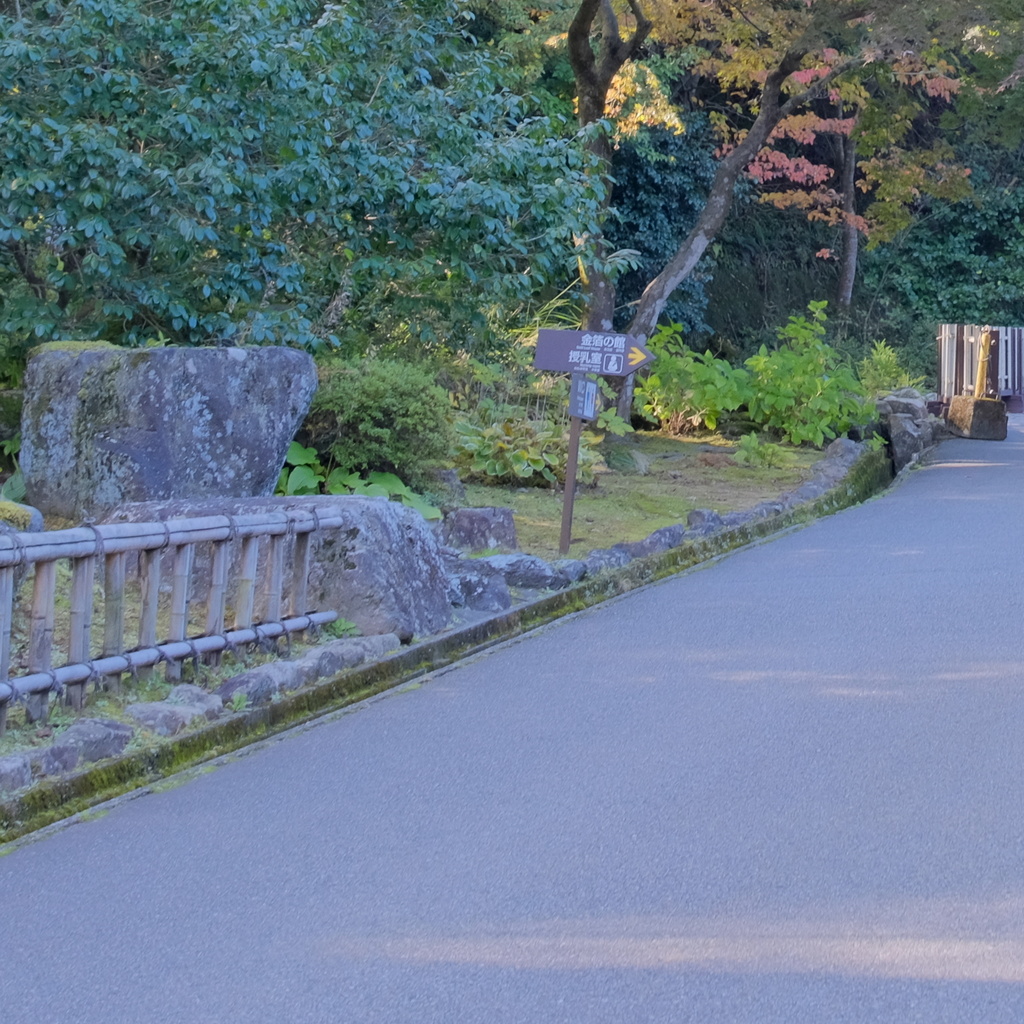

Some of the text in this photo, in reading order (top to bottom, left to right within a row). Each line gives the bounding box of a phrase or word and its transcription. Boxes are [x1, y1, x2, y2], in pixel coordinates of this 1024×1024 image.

[581, 334, 626, 349] 金箔の館
[568, 350, 602, 364] 授乳室
